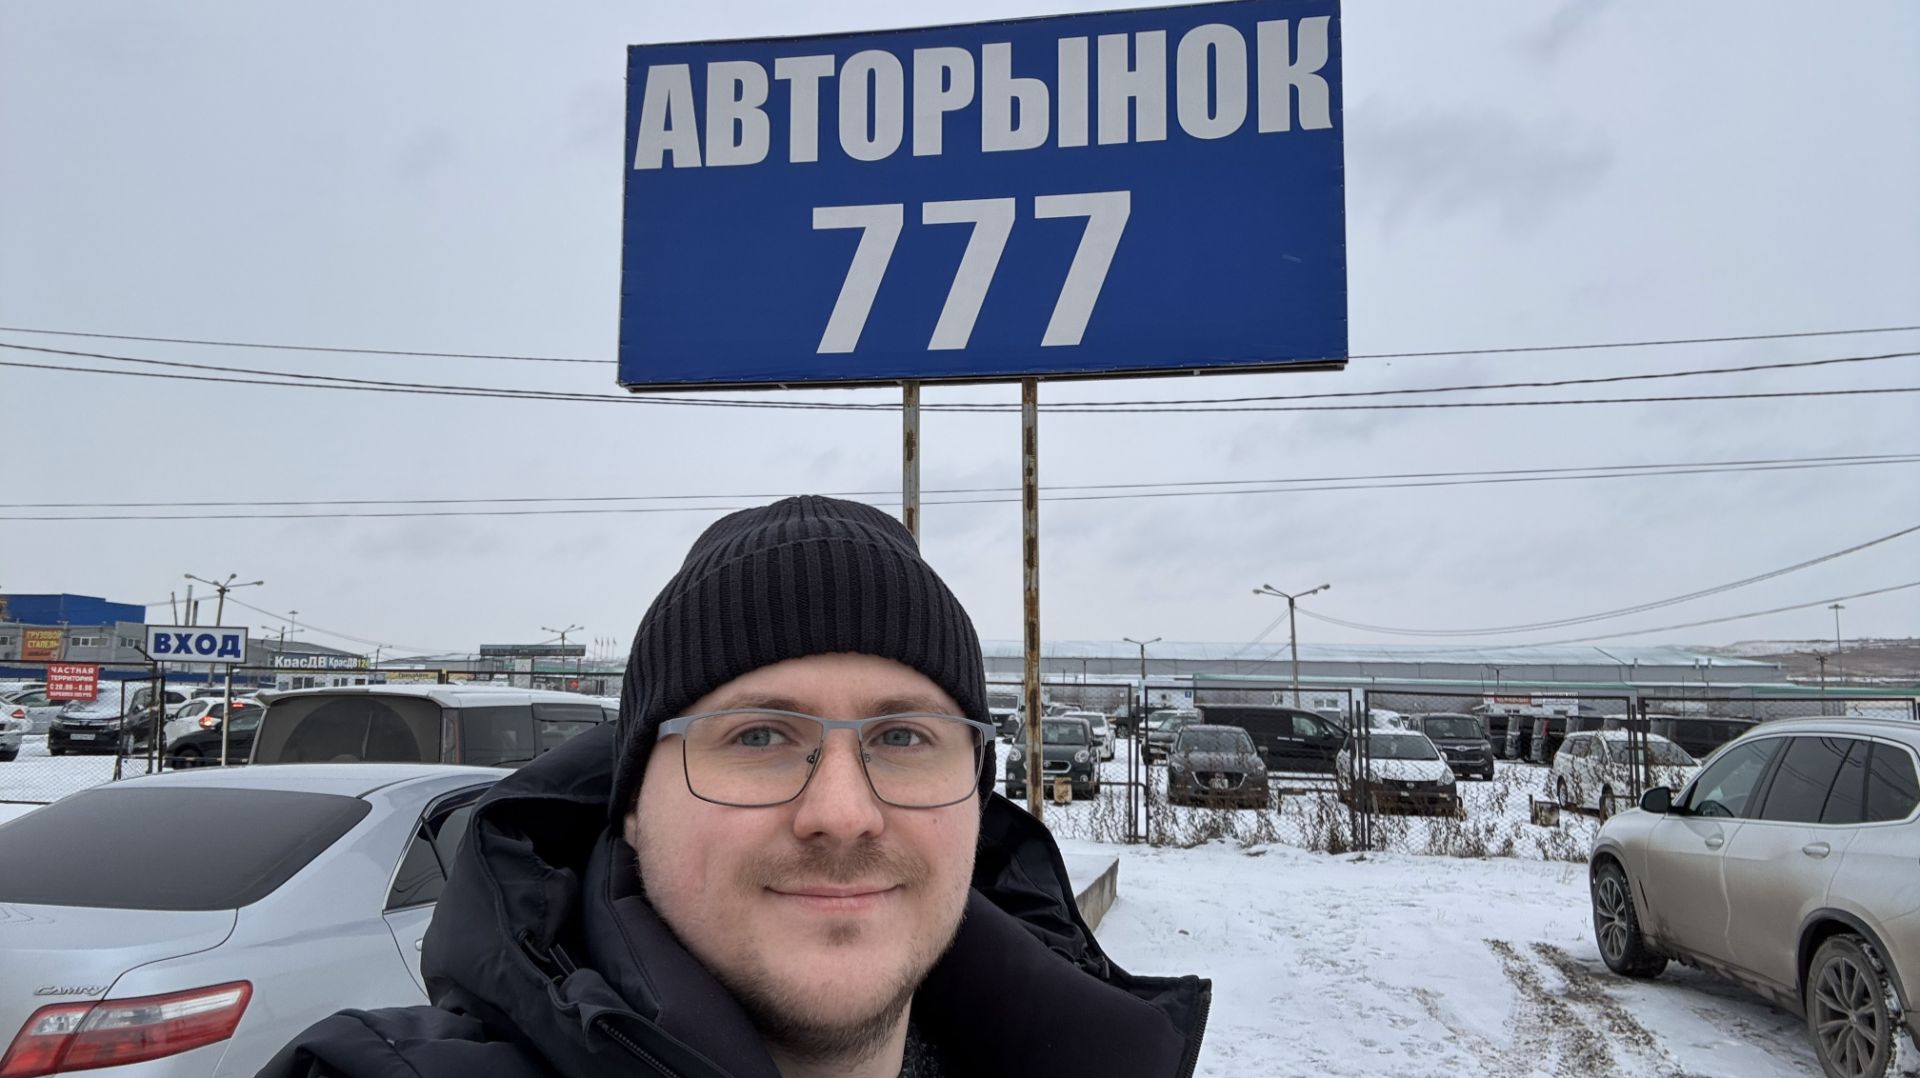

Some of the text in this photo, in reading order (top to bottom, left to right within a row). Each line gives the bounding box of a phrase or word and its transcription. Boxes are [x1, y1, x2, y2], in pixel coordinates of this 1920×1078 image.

[633, 15, 1334, 171] АВТОРЫНОК
[812, 190, 1132, 355] 777
[153, 632, 241, 658] ВХОД
[50, 666, 94, 674] ЧАСТНАЯ
[274, 656, 326, 668] КрасДВ
[34, 985, 107, 997] CAMRY
